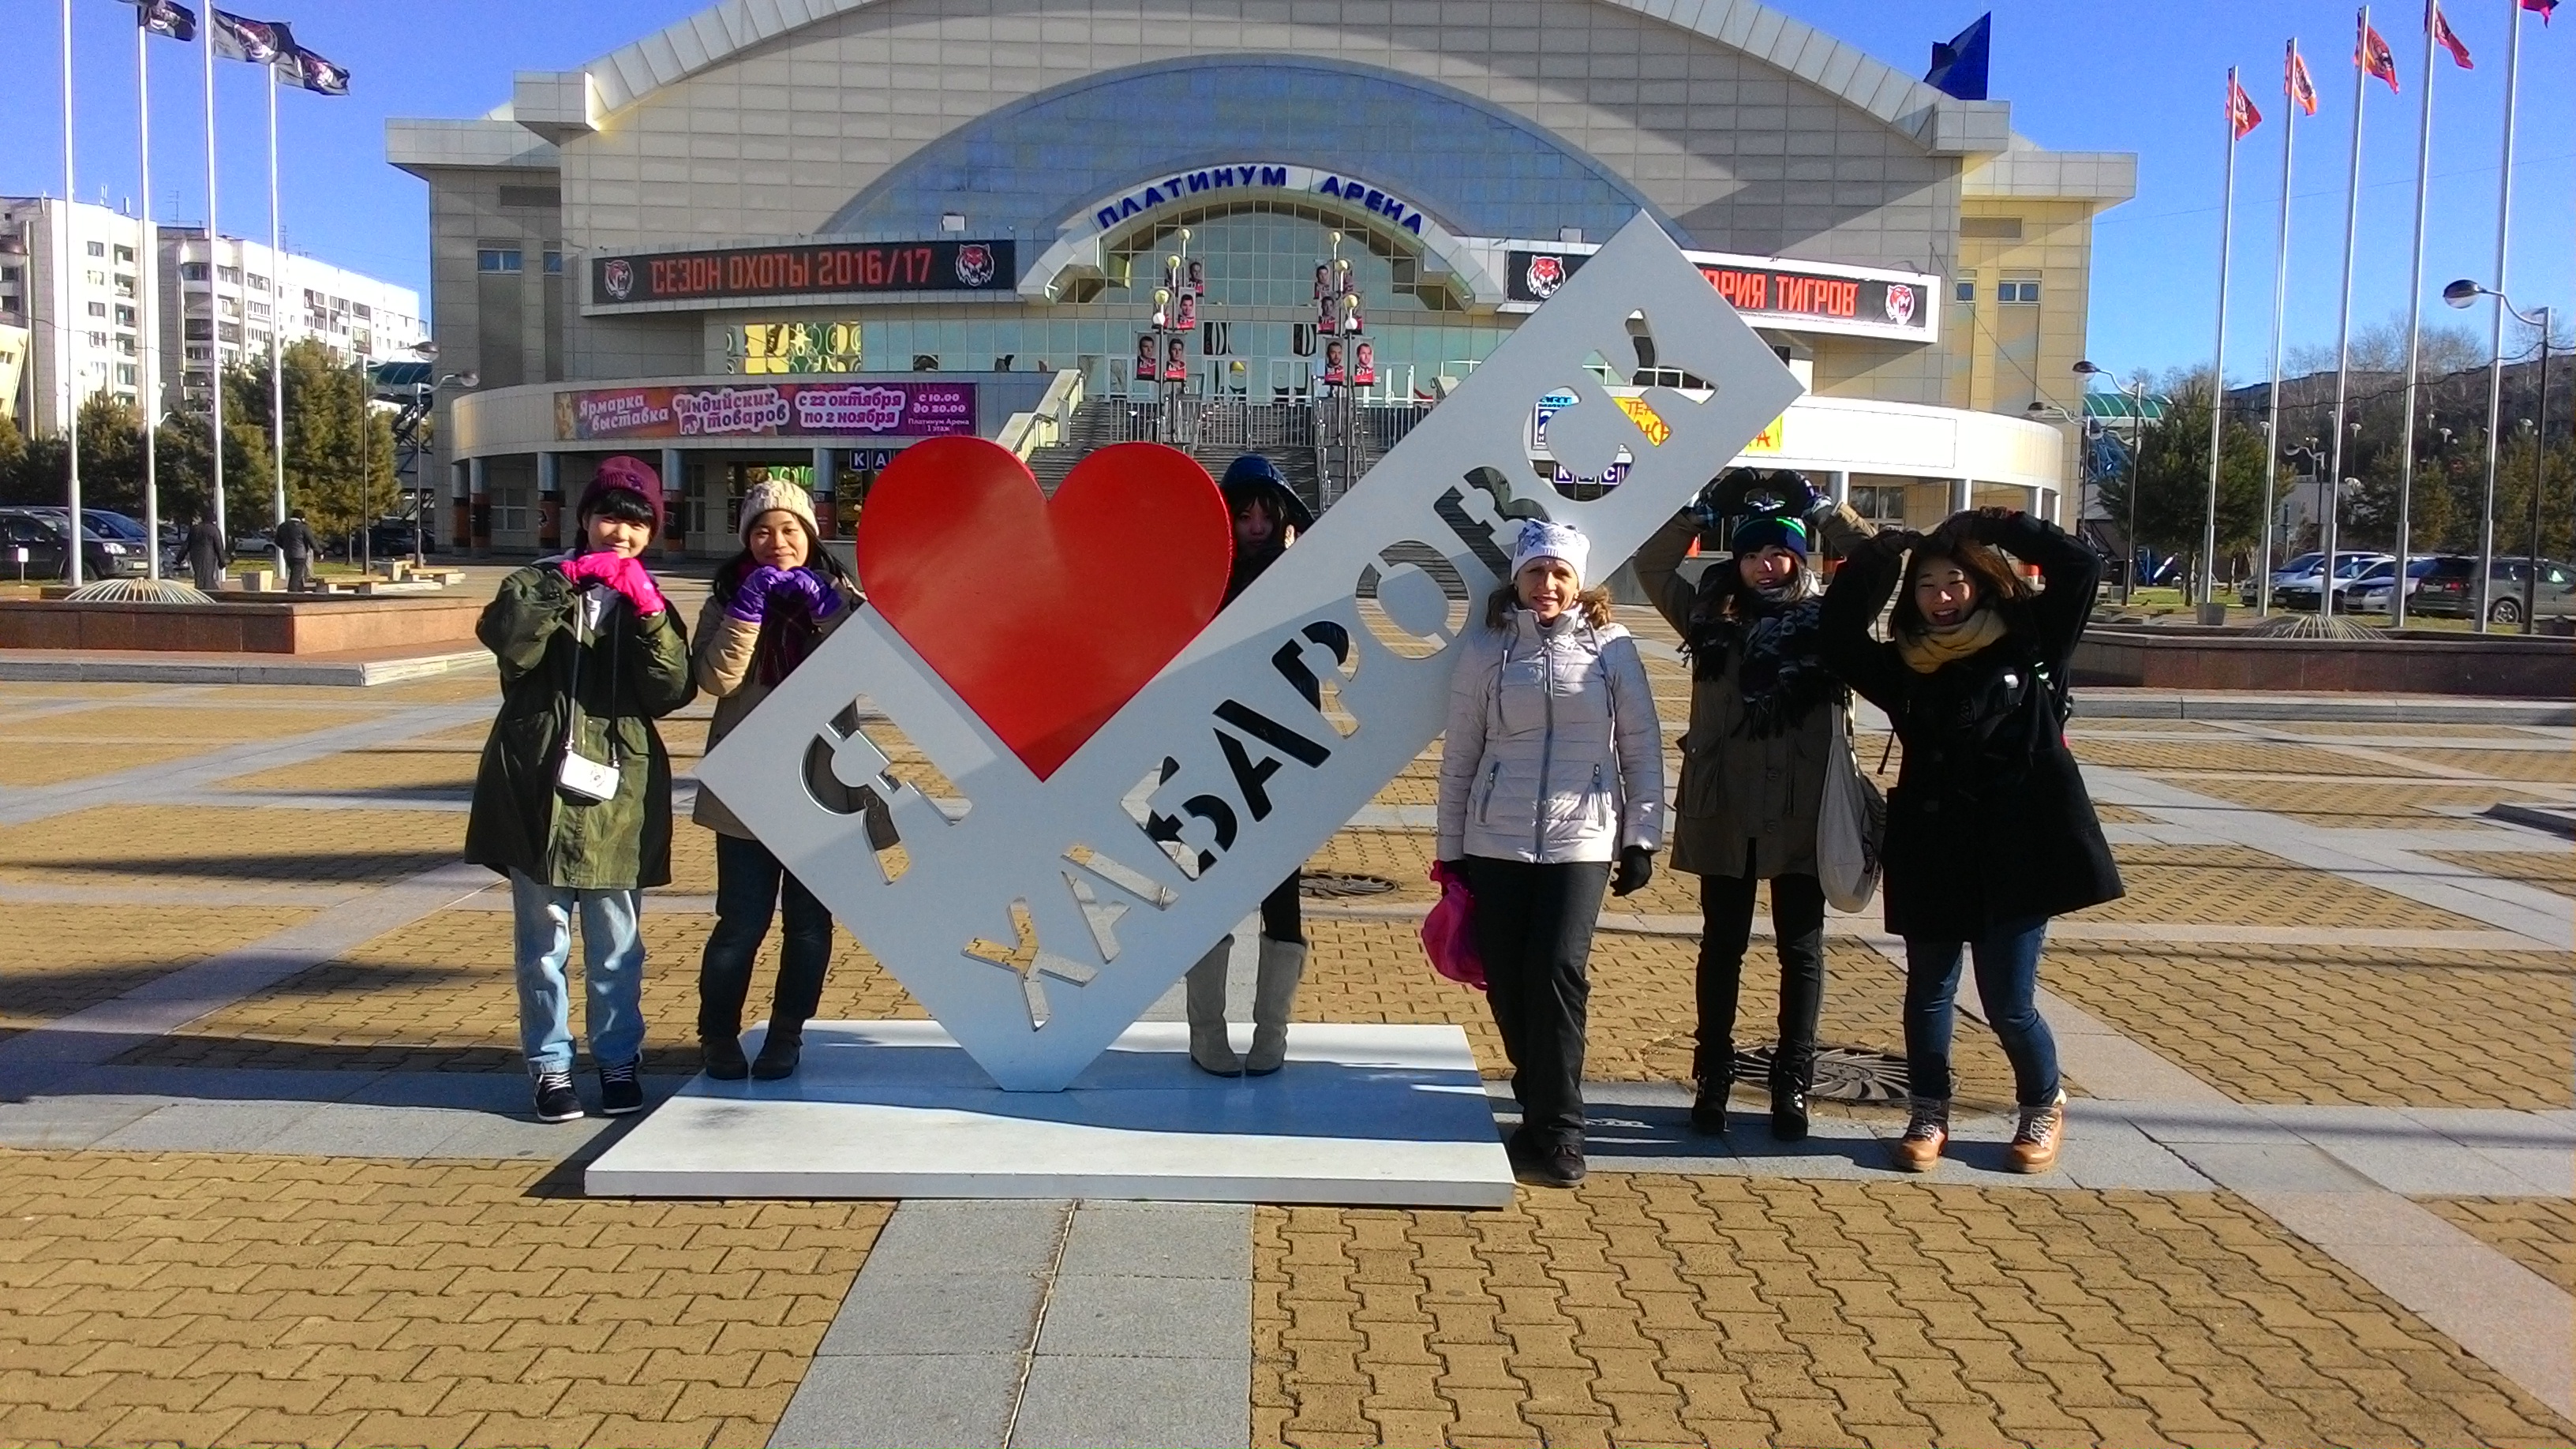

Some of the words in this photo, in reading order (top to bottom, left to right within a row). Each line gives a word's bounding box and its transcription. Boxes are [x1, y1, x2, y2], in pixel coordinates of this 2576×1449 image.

[1096, 165, 1287, 228] ПЛАТИНУМ
[1320, 175, 1422, 236] АРЕНА
[650, 258, 721, 294] СЕЗОН
[729, 253, 810, 290] ОХОТЫ
[818, 248, 932, 286] 2016/17
[1699, 268, 1767, 309] ОРИЯ
[1776, 275, 1859, 317] ТИГРОВ
[579, 395, 644, 419] Ярмарка
[676, 392, 775, 414] Индийских
[799, 395, 807, 406] с
[810, 395, 826, 406] 22
[829, 391, 902, 410] октября
[913, 402, 929, 414] до
[931, 404, 967, 414] 20.00
[919, 394, 927, 402] с
[929, 393, 960, 402] 10.00
[593, 406, 669, 432] выставка
[707, 403, 786, 428] товаров
[804, 412, 823, 423] по
[826, 412, 835, 423] 2
[837, 410, 896, 427] ноября
[946, 417, 970, 426] Арена
[854, 452, 886, 466] КА
[960, 309, 1719, 1032] ХАБАРОВСК
[799, 693, 973, 886] Я
